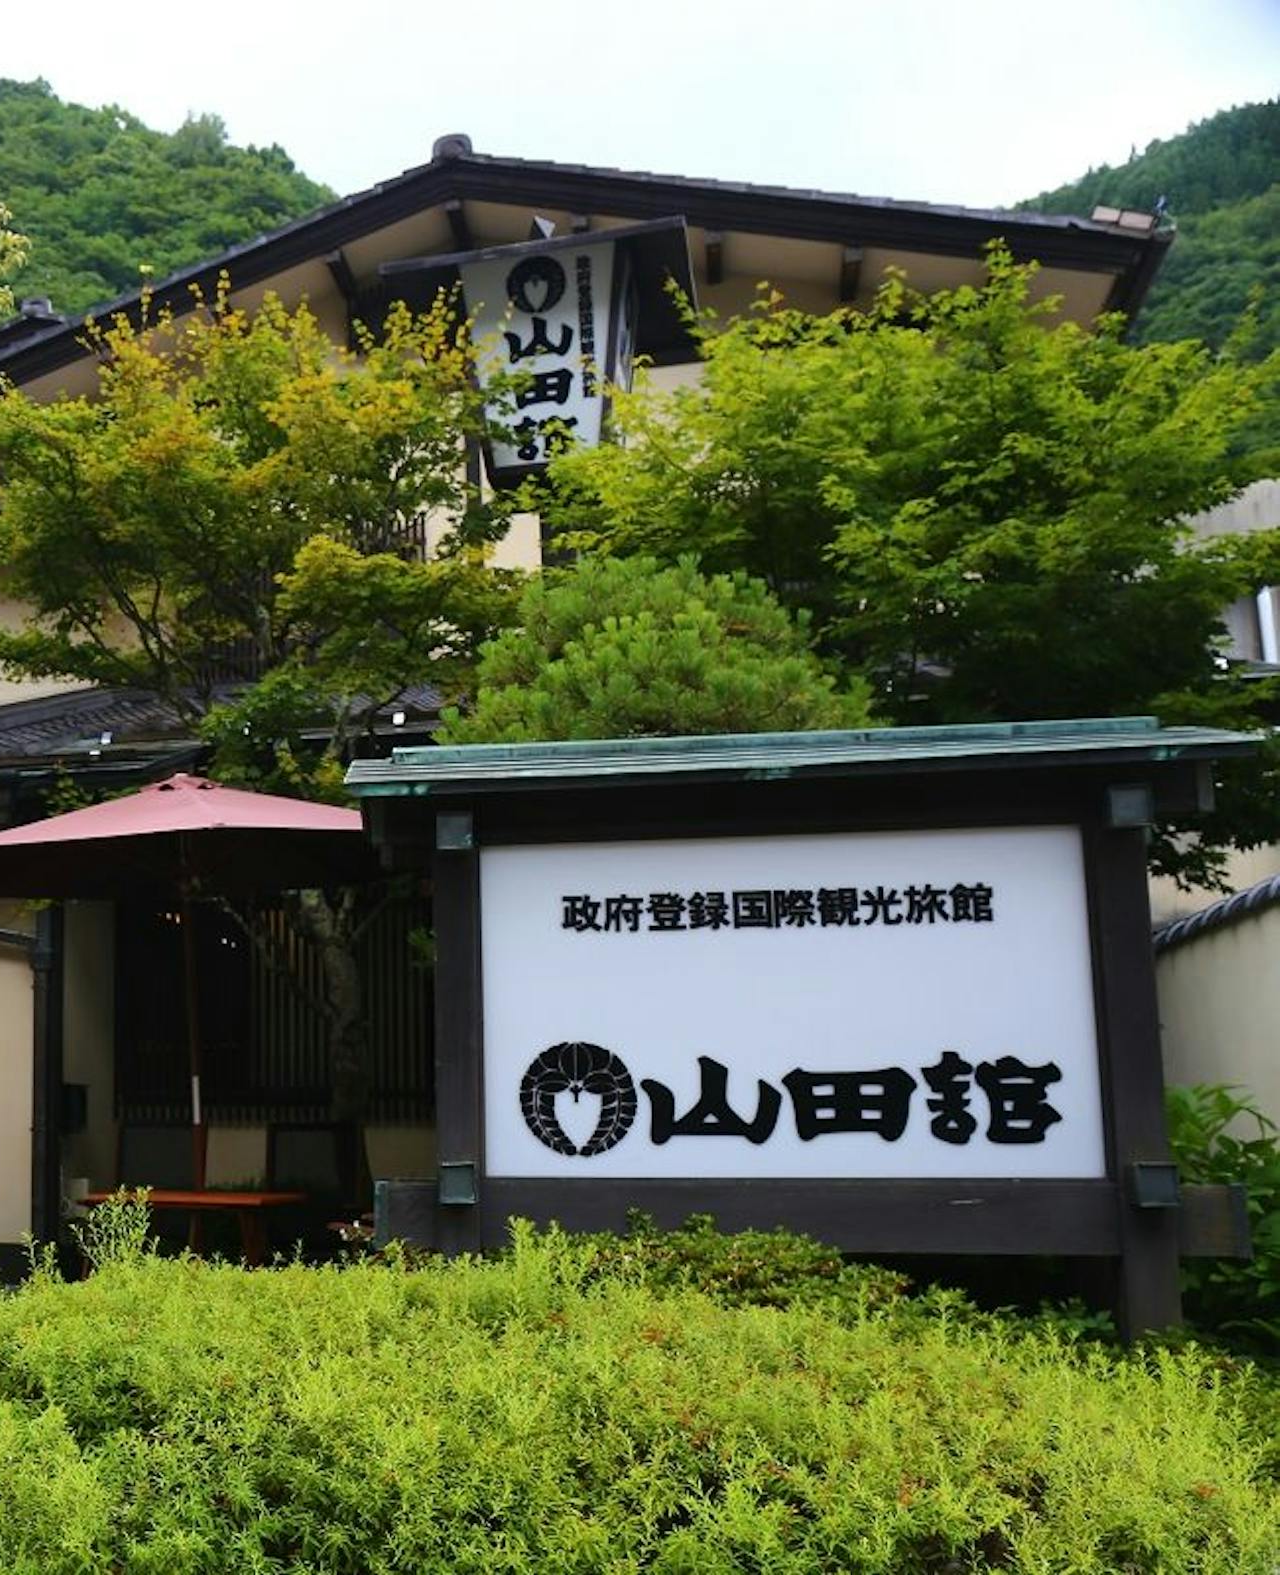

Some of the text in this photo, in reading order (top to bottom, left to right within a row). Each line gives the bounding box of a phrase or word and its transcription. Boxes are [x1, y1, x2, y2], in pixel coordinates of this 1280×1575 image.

[562, 883, 993, 932] 政府登録国際観光旅館
